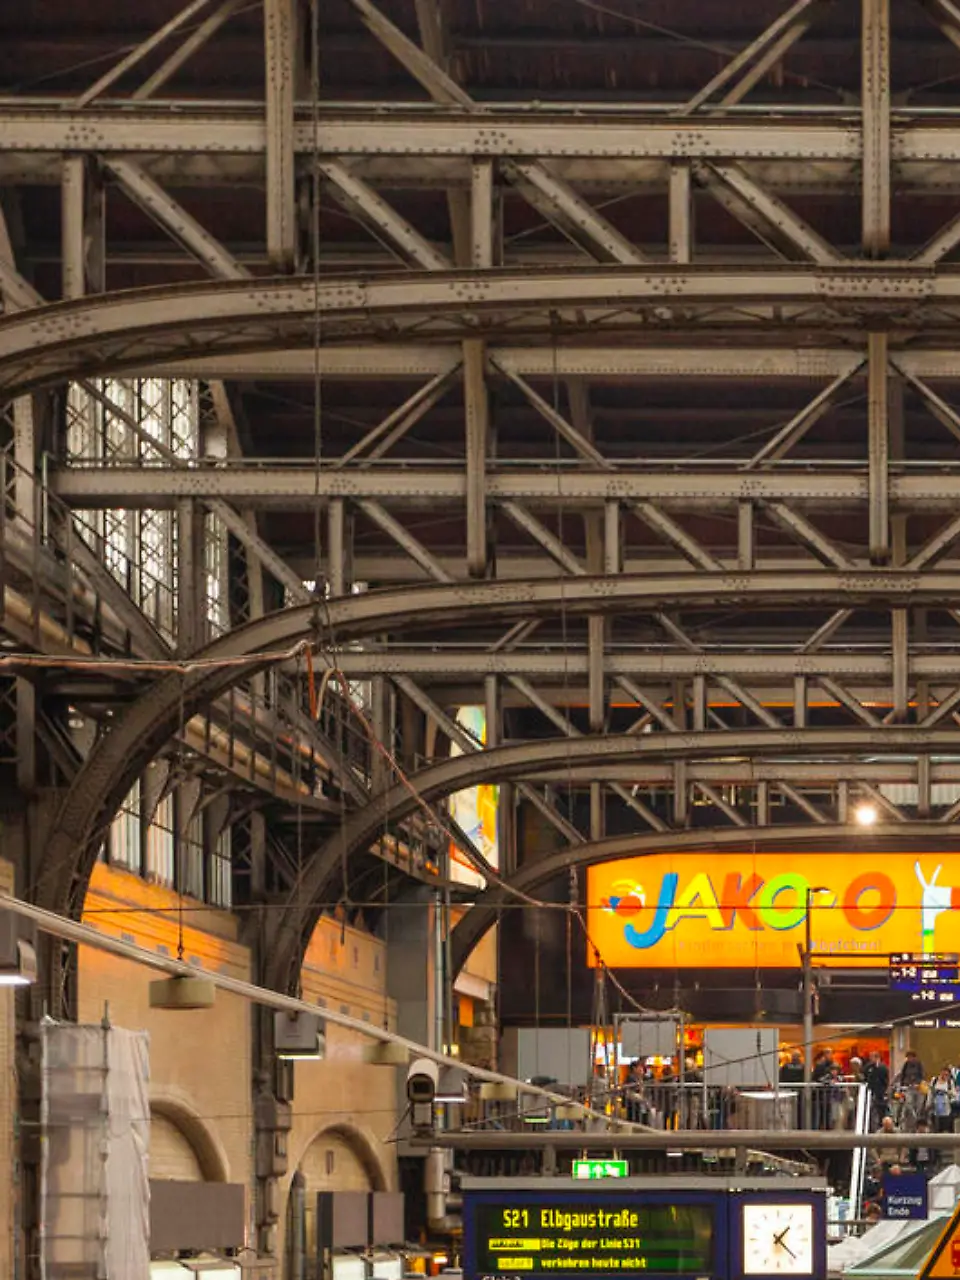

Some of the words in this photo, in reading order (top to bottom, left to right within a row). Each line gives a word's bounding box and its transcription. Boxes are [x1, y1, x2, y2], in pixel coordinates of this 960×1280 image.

[624, 871, 897, 949] JAKO-O
[503, 1209, 528, 1228] S21
[541, 1208, 639, 1231] Elbgaustraße
[581, 1238, 598, 1249] der
[600, 1238, 622, 1249] Linie
[541, 1257, 589, 1269] verkehren
[591, 1257, 620, 1269] heute
